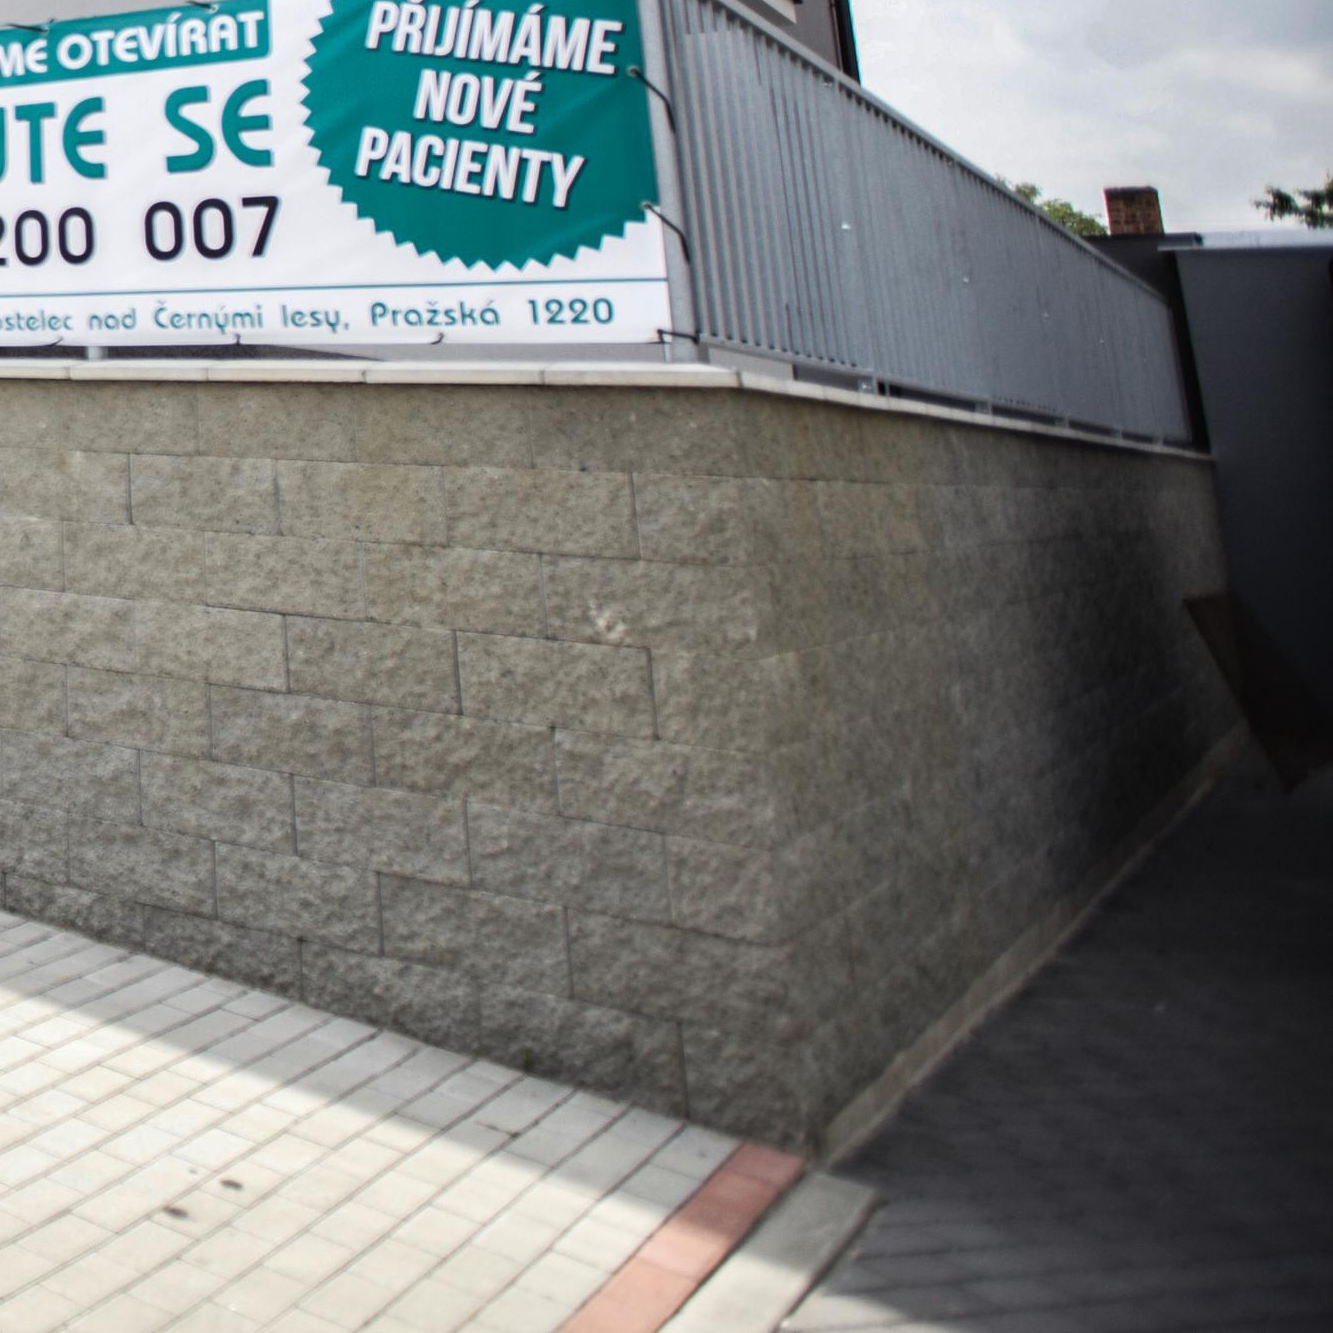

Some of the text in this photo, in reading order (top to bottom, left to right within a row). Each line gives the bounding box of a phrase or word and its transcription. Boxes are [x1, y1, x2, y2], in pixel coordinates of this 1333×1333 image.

[57, 10, 265, 70] OTEVÍRAT
[163, 77, 274, 174] SE
[413, 68, 542, 134] NOVÉ
[354, 126, 585, 208] PACIENTY
[143, 195, 282, 263] 007
[89, 308, 137, 330] nad
[153, 299, 264, 335] Černými
[282, 304, 350, 334] lesy,
[370, 299, 501, 327] Pražská
[528, 297, 614, 325] 1220
